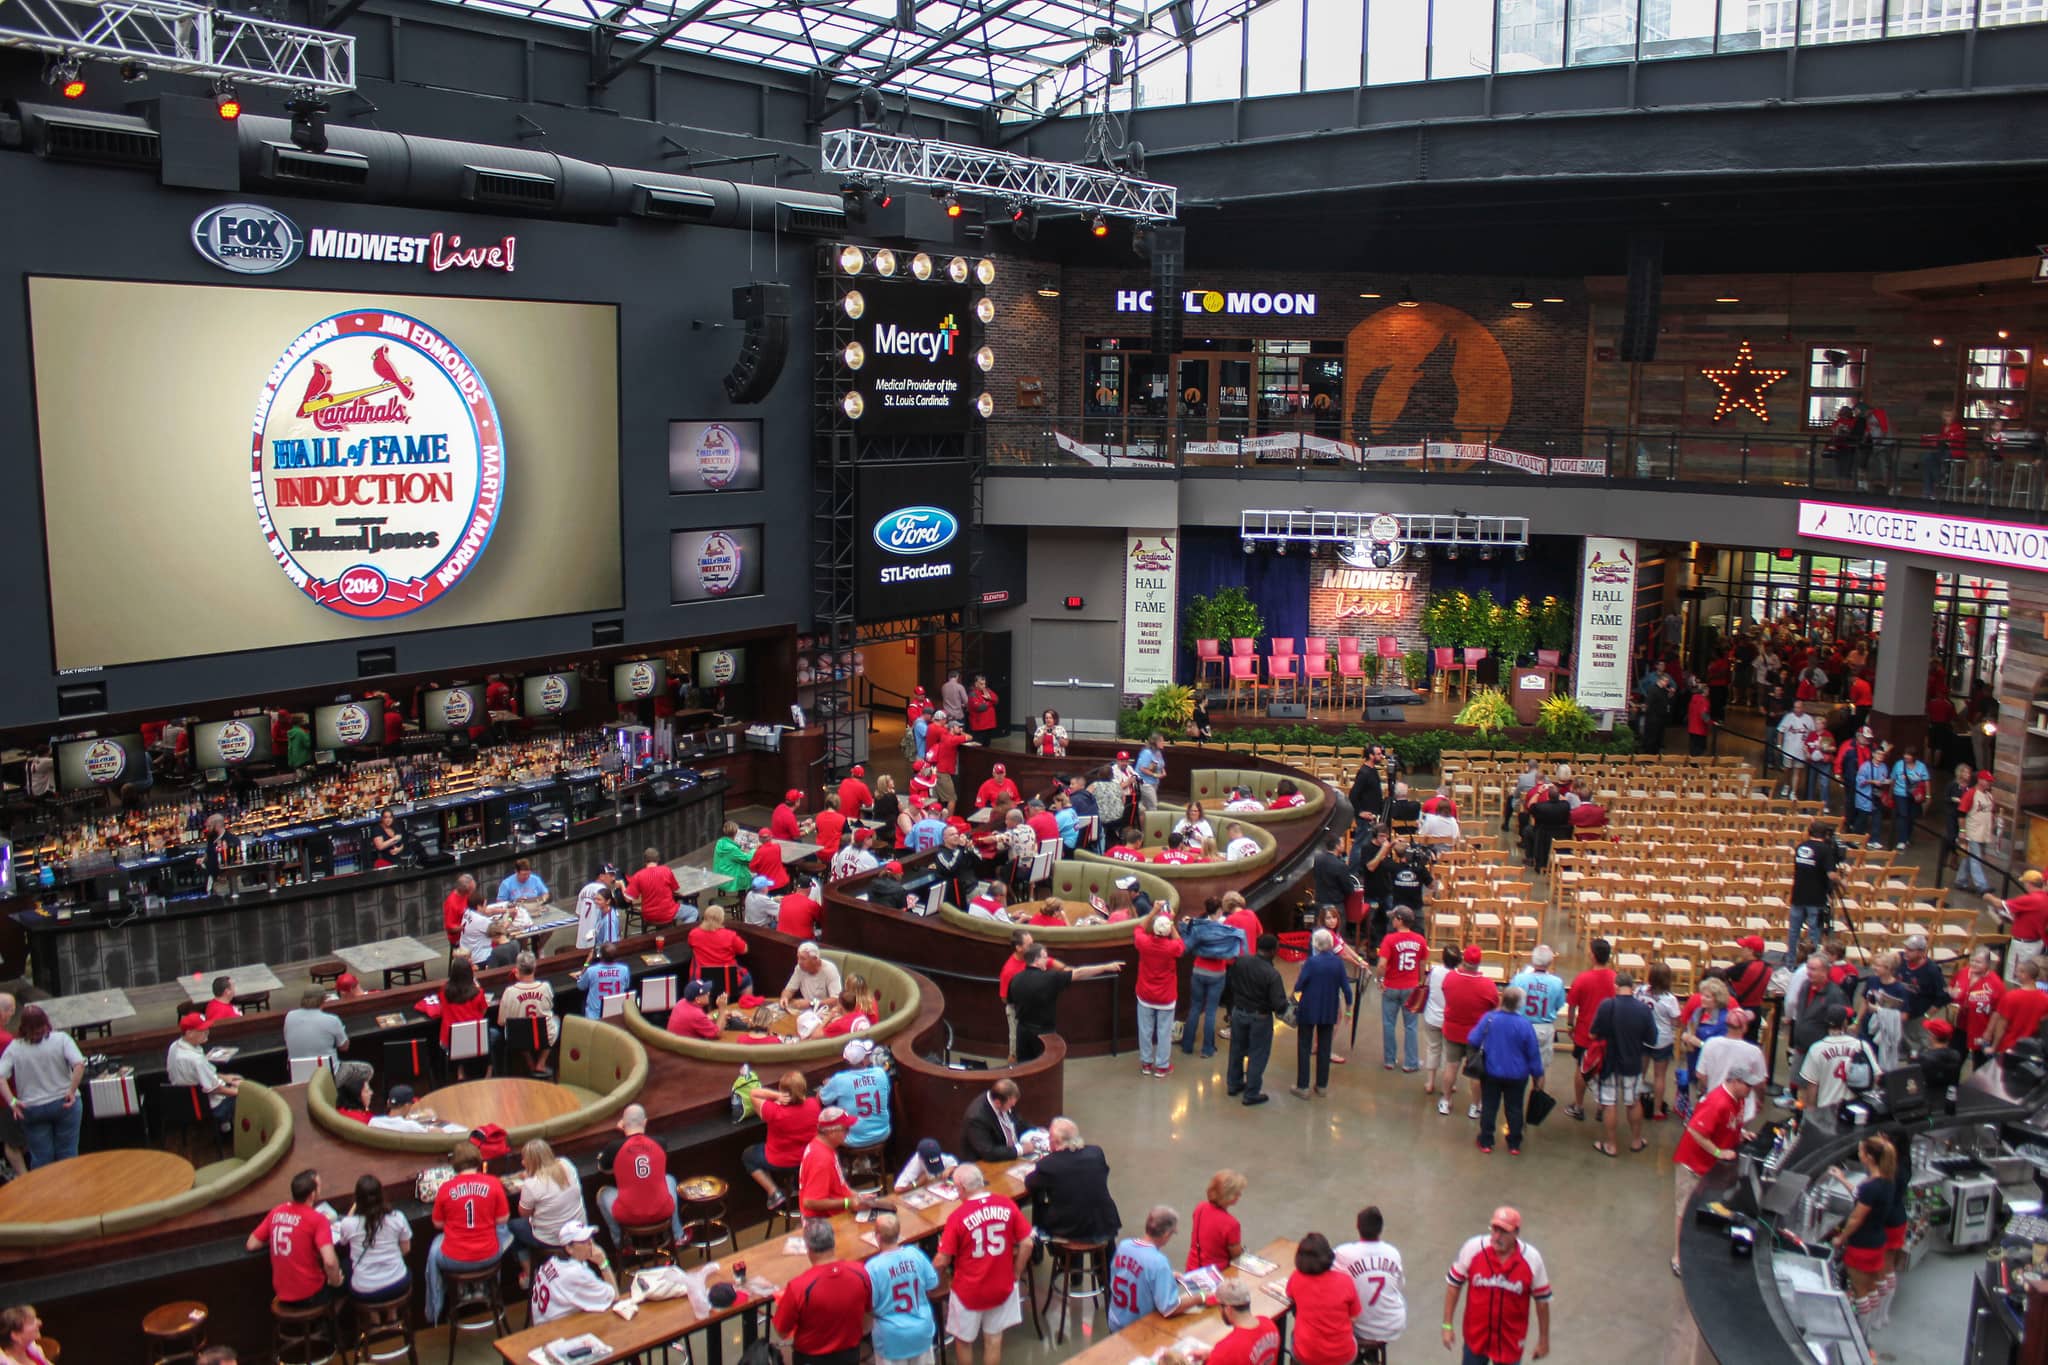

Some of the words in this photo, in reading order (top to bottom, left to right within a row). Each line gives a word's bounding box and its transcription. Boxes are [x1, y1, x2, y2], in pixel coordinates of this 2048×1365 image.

[217, 216, 282, 247] FOX
[220, 246, 283, 259] SPORTS
[310, 228, 430, 263] MIDWEST
[431, 231, 516, 273] Live!
[1117, 290, 1202, 313] HOL
[1227, 292, 1315, 314] MOON
[875, 323, 942, 363] Mercy
[408, 324, 484, 404] EDMONDS
[875, 378, 906, 391] Medical
[907, 379, 938, 392] Provider
[938, 379, 947, 392] of
[947, 379, 957, 391] the
[884, 394, 894, 406] St.
[896, 394, 914, 406] Louis
[915, 394, 949, 406] Cardinals
[313, 396, 416, 432] Cardinals
[272, 436, 347, 469] HALL
[346, 439, 369, 467] of
[371, 434, 450, 466] FAME
[274, 472, 454, 507] INDUCTION
[481, 445, 500, 520] MARTY
[890, 513, 941, 546] Ford
[1847, 511, 1918, 543] MCGEE
[367, 526, 440, 554] Jones
[436, 518, 490, 588] MARION
[880, 562, 951, 583] STLFord.com
[1135, 577, 1167, 590] HALL
[1322, 569, 1418, 590] MIDWEST
[344, 577, 379, 594] 2014
[1145, 590, 1155, 600] of
[1592, 590, 1624, 602] HALL
[1134, 601, 1166, 614] FAME
[1335, 591, 1404, 618] Live!
[1602, 603, 1612, 614] of
[1137, 621, 1163, 629] EDMONDS
[1590, 614, 1622, 626] FAME
[918, 836, 934, 850] 51
[585, 901, 593, 918] 7
[1398, 952, 1417, 971] 15
[598, 981, 620, 999] 51
[525, 1005, 537, 1018] 6
[1525, 995, 1548, 1018] 51
[1976, 1002, 1991, 1015] 24
[853, 1075, 877, 1089] McGEE
[1833, 1061, 1847, 1082] 4
[855, 1090, 882, 1118] 51
[635, 1156, 650, 1179] 6
[450, 1183, 489, 1200] SMITH
[272, 1213, 301, 1226] EDMONDS
[464, 1200, 474, 1228] 1
[963, 1206, 1011, 1231] EDMONDS
[271, 1226, 293, 1257] 15
[971, 1223, 1006, 1258] 15
[888, 1260, 916, 1278] McGEE
[892, 1279, 919, 1313] 51
[1112, 1276, 1140, 1314] 51
[1368, 1276, 1385, 1306] 7
